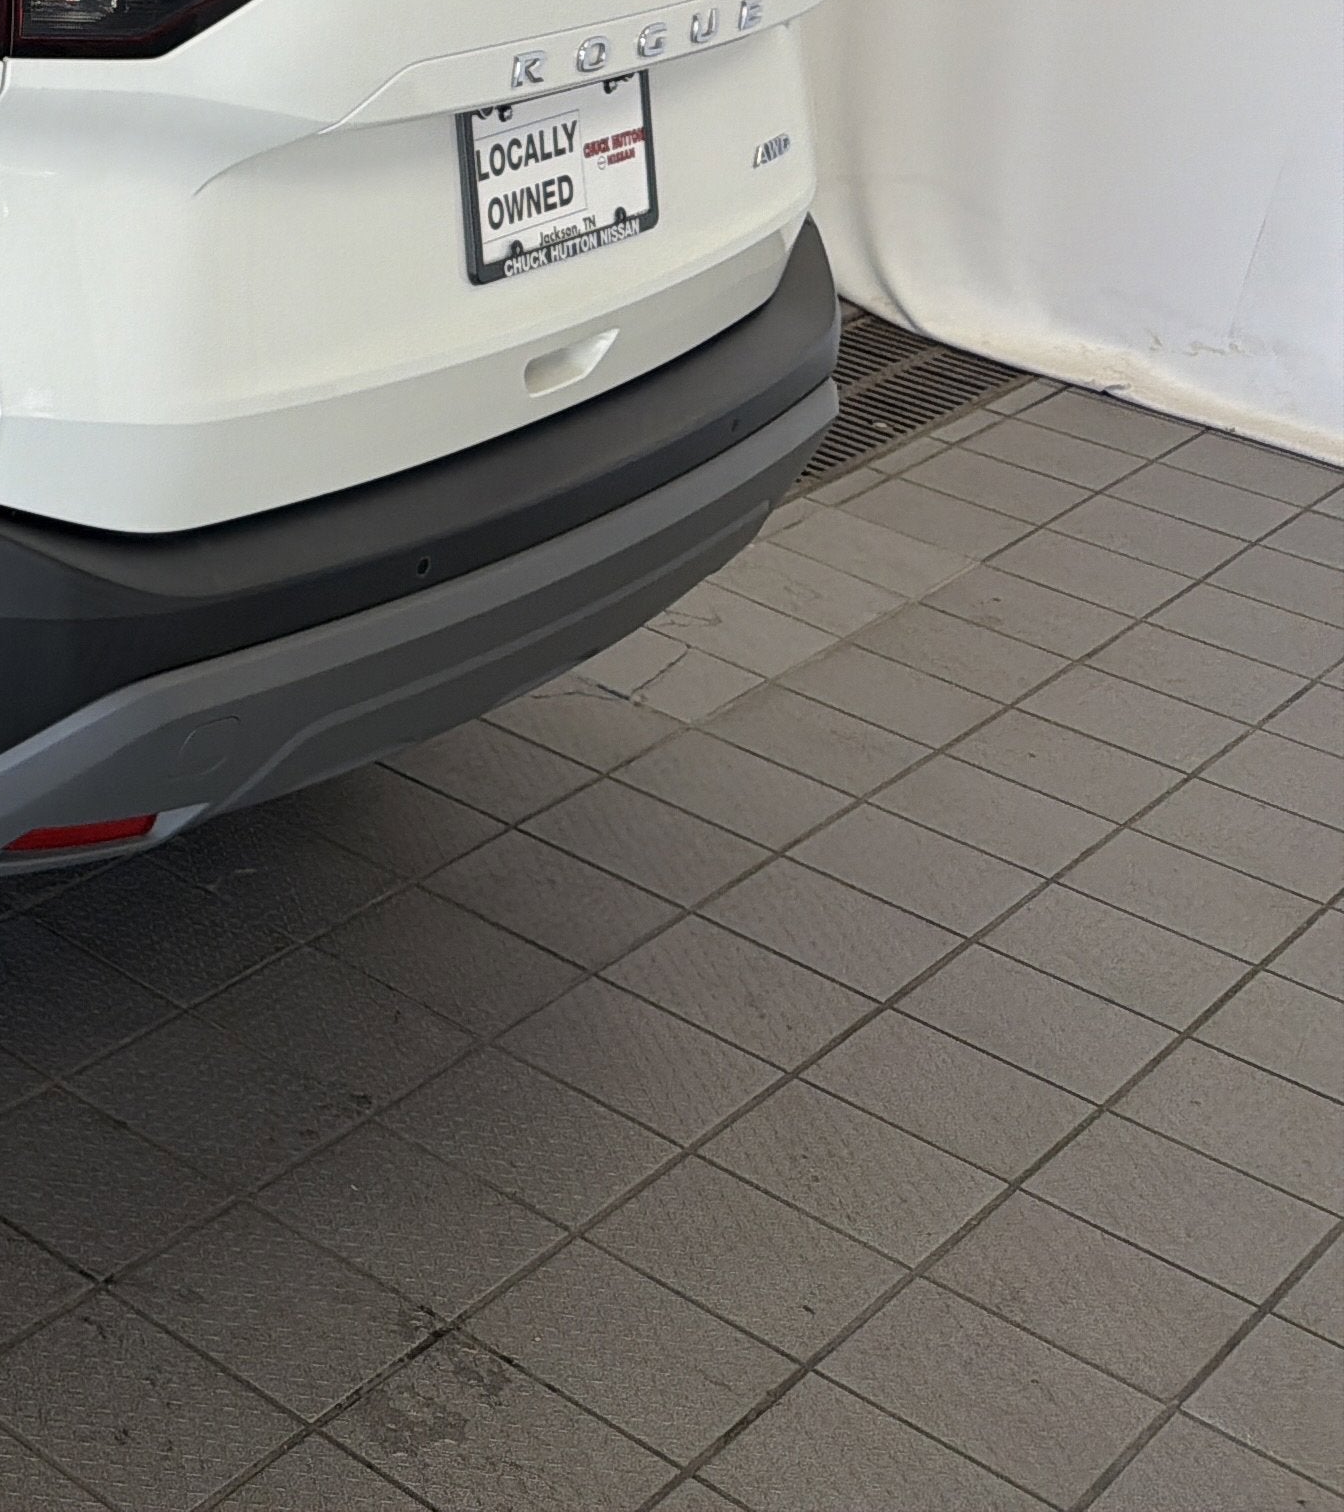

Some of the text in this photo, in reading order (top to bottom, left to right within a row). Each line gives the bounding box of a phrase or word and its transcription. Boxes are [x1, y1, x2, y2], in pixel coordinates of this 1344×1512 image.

[476, 120, 578, 182] LOCALLY
[488, 175, 574, 230] OWNED
[582, 214, 597, 230] TN
[503, 218, 640, 277] CHUCK HUTTON NISSAN
